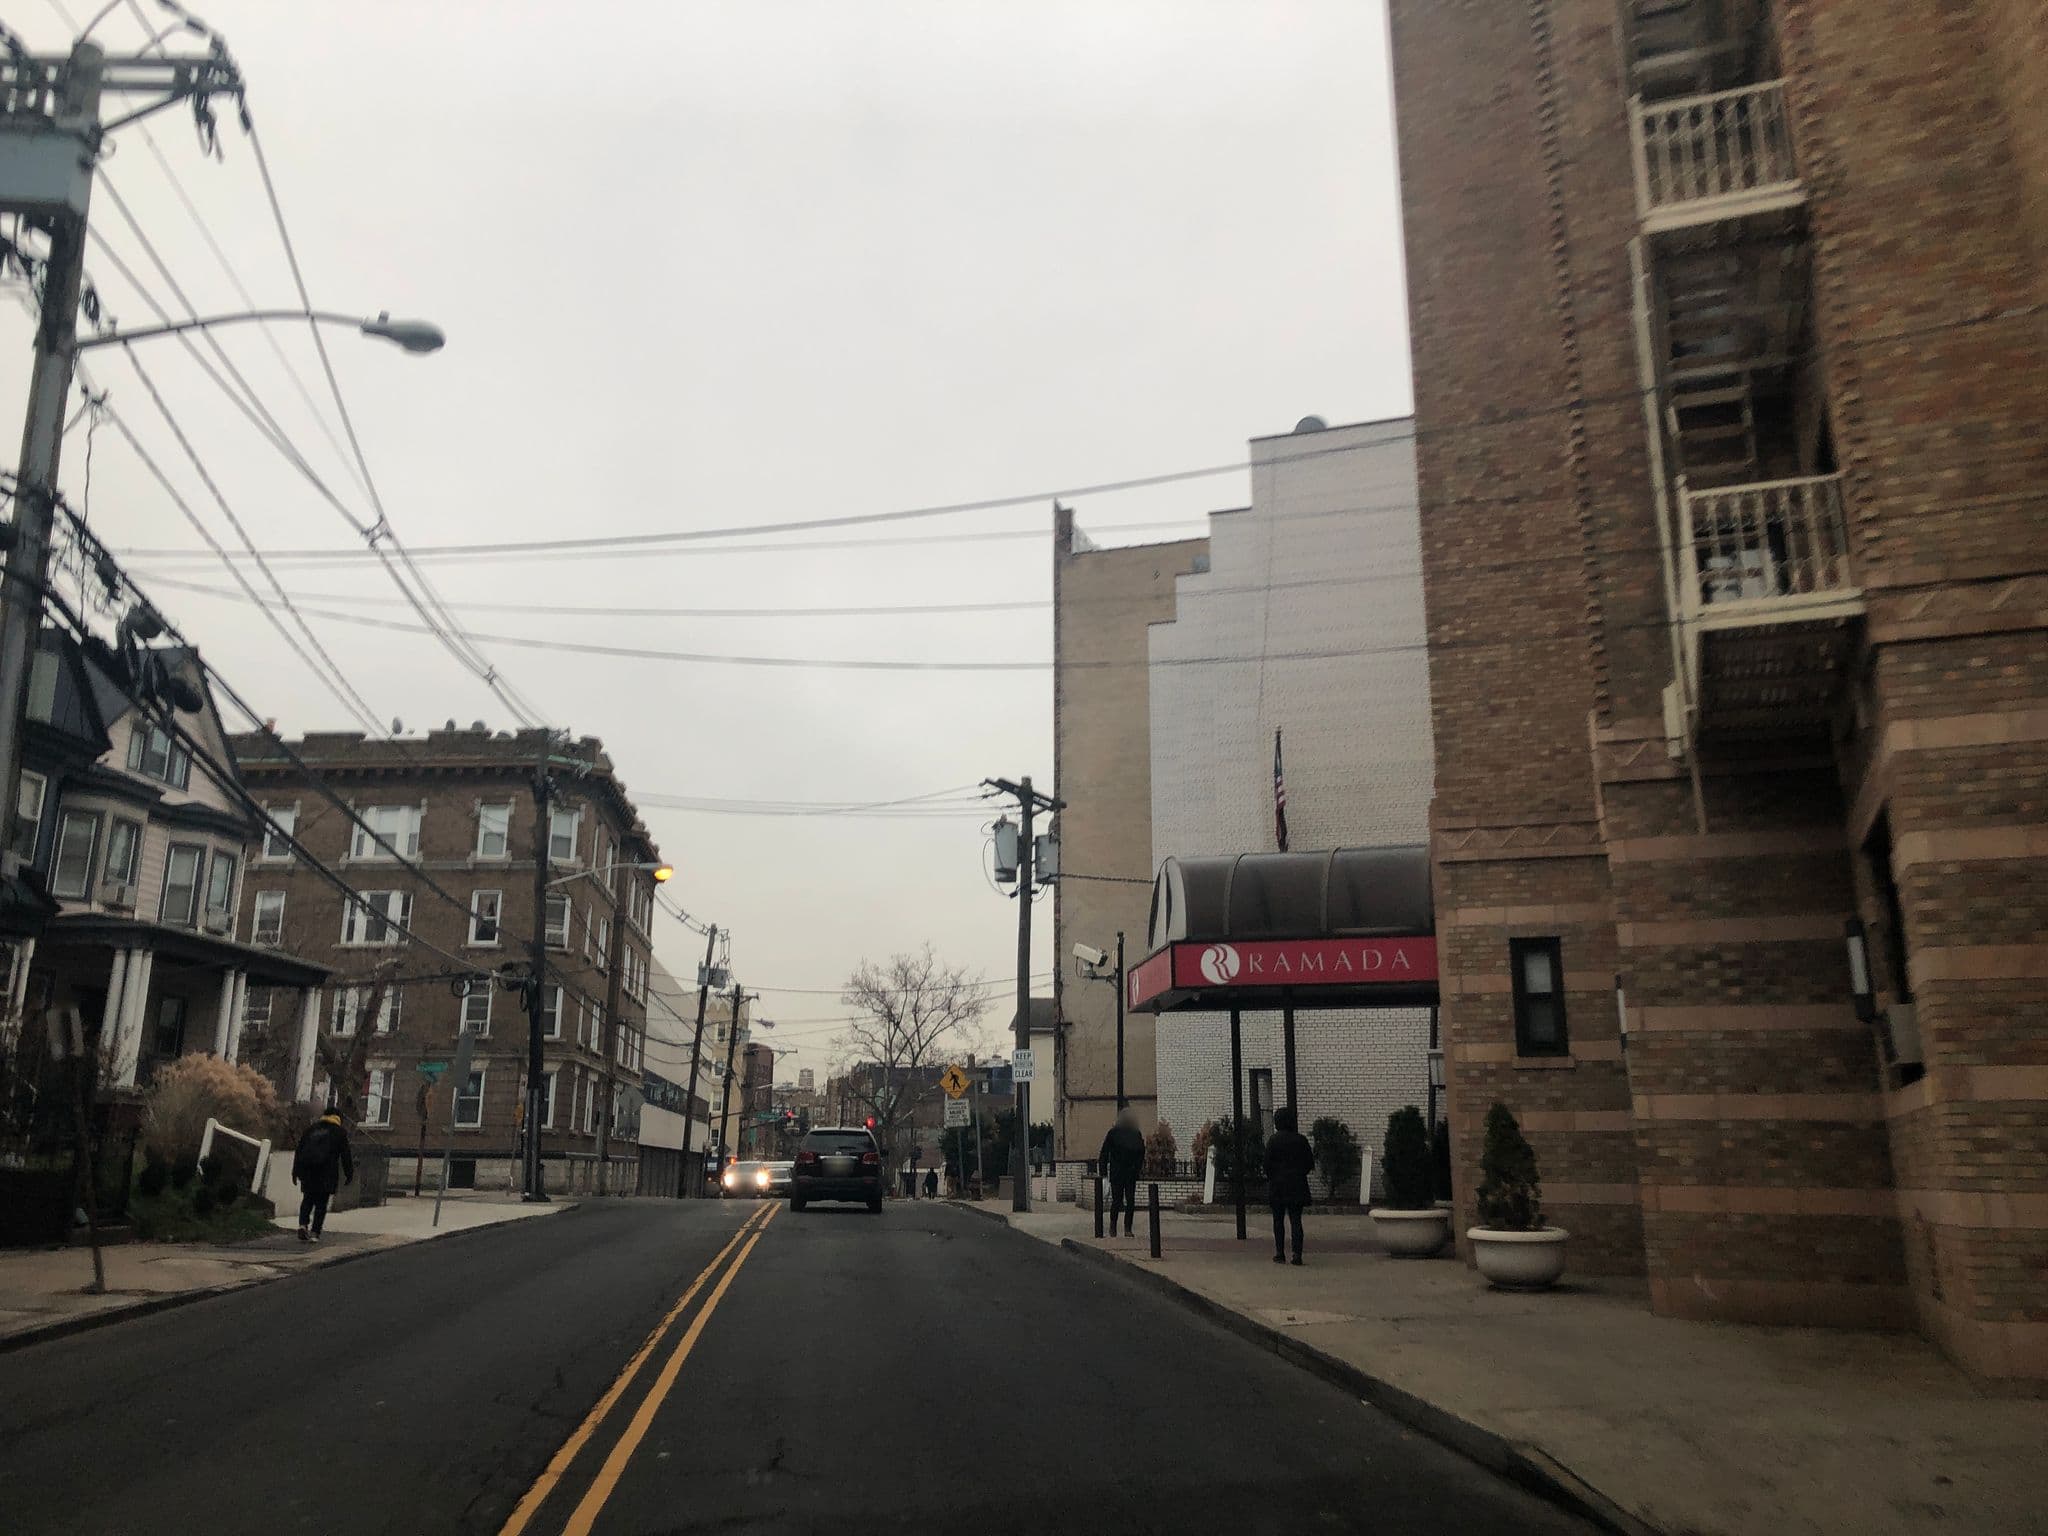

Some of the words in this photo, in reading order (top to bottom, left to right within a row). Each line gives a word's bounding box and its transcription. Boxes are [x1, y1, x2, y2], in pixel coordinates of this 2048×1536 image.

[1249, 949, 1411, 973] RAMADA
[1015, 1052, 1032, 1060] KEEP
[1015, 1070, 1033, 1078] CLEAR
